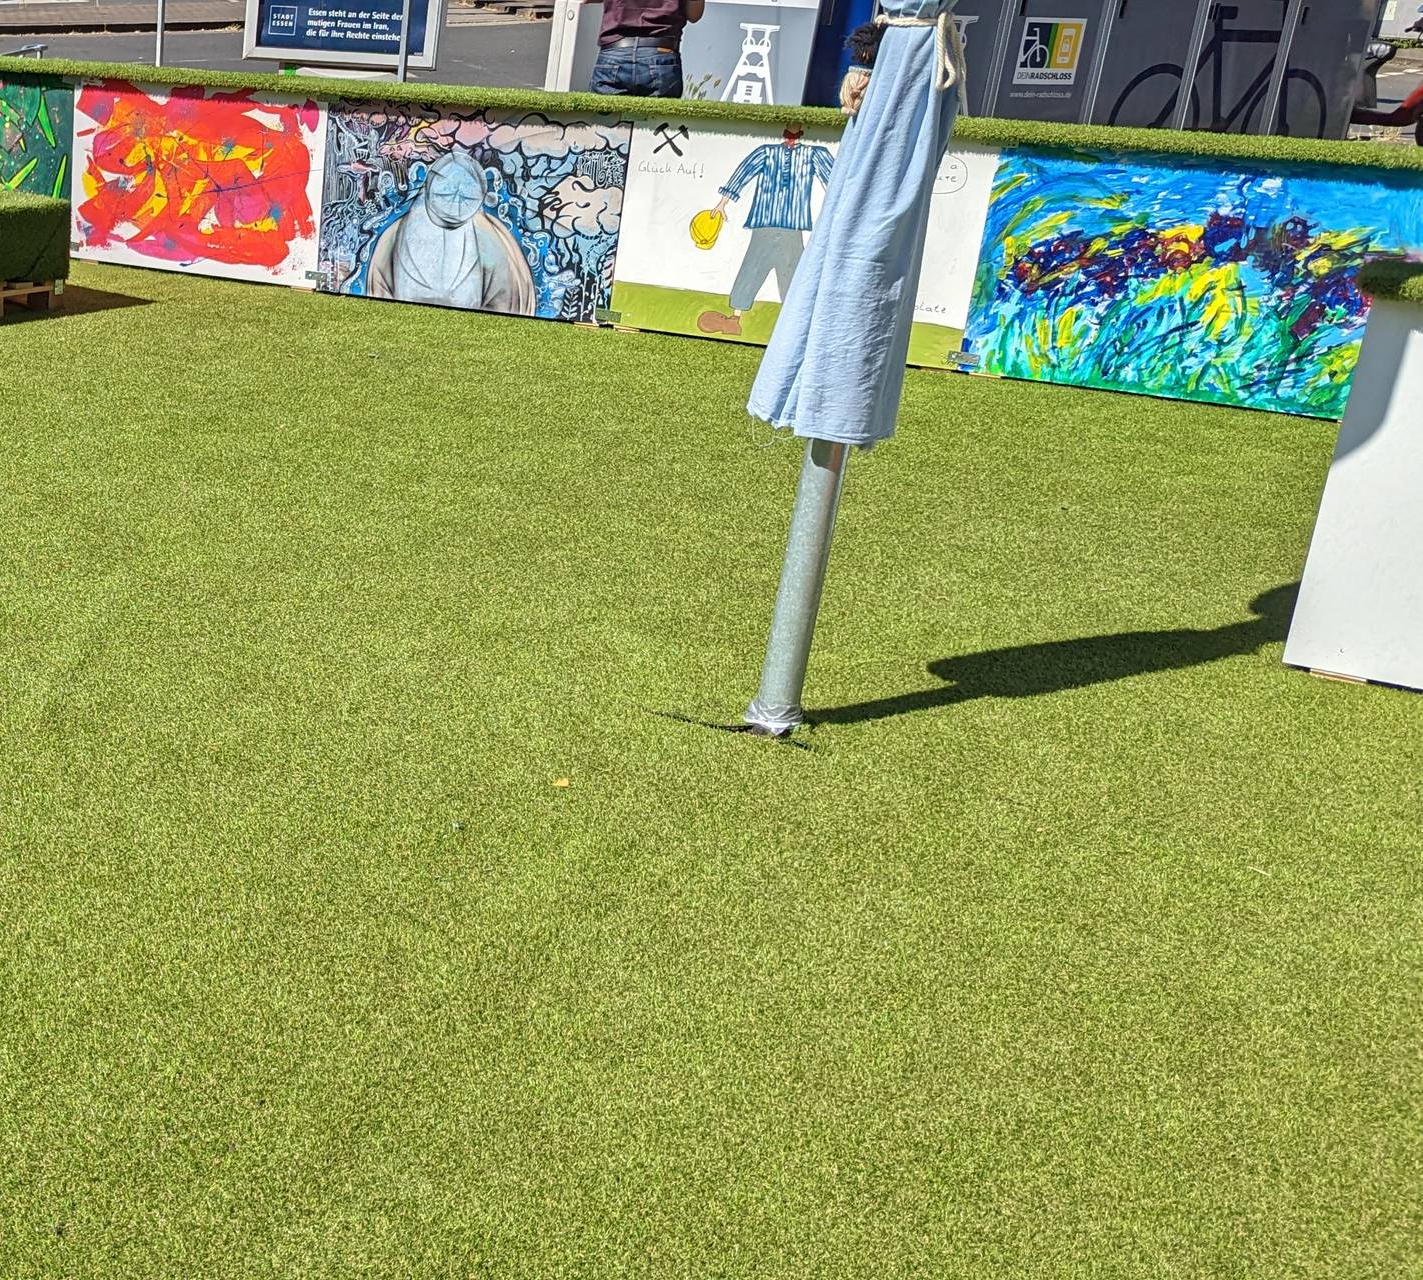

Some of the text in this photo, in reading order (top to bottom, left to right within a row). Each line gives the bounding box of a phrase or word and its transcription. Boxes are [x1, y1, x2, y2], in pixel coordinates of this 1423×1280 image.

[308, 8, 327, 17] Essen
[328, 9, 347, 18] steht
[358, 11, 371, 19] der
[372, 11, 390, 20] Seite
[307, 20, 335, 28] mutigen
[337, 20, 361, 29] Frauen
[373, 22, 389, 31] Iran,
[306, 28, 401, 41] die für ihre Rechte einstehe
[638, 160, 705, 179] Glück Auf!
